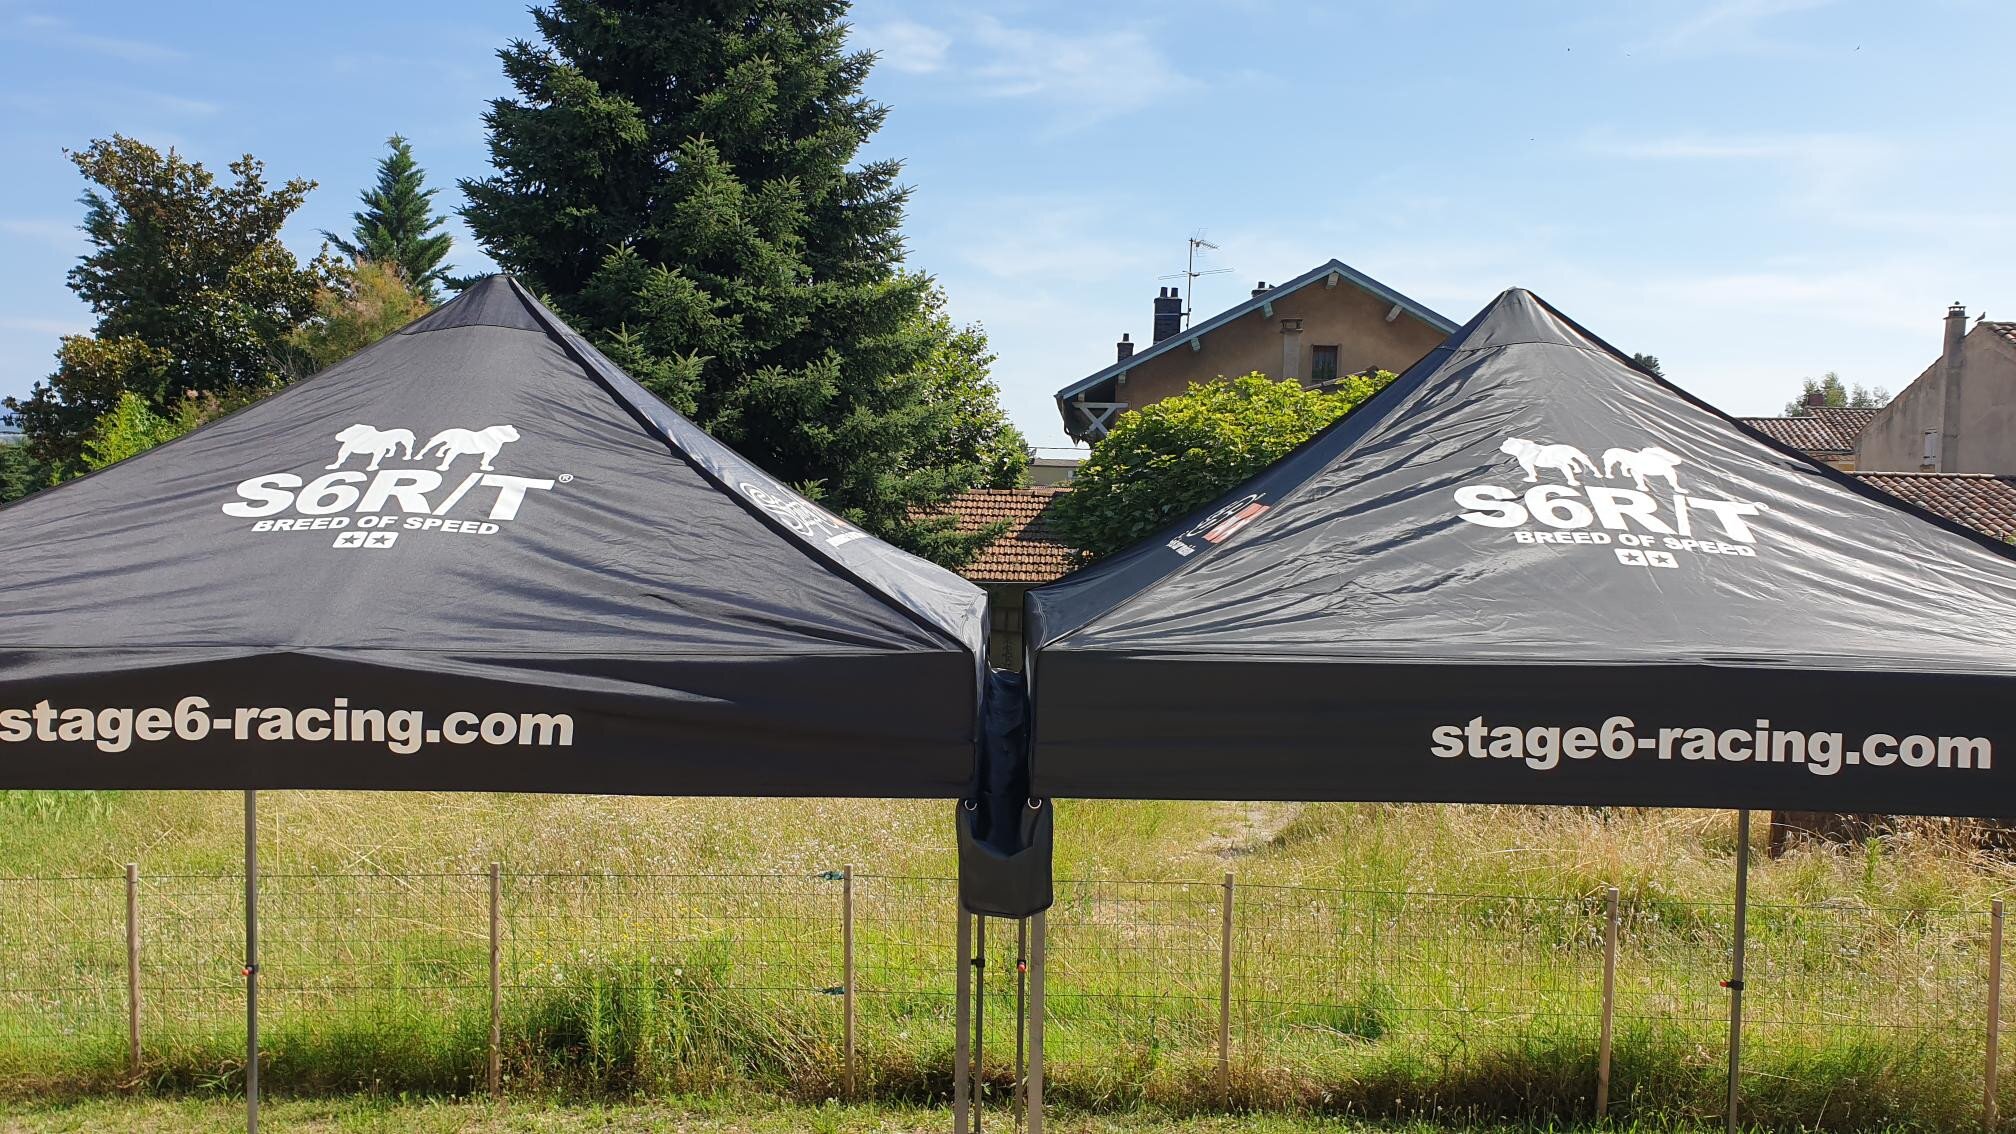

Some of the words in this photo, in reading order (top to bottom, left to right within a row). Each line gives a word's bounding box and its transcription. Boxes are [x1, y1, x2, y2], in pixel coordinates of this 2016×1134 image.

[251, 516, 350, 532] BREED
[357, 515, 399, 529] OF
[403, 517, 500, 535] SPEED
[1513, 531, 1612, 545] BREED
[1619, 532, 1655, 547] OF
[1663, 537, 1757, 557] SPEED
[0, 696, 574, 754] stage6-racing.com
[1431, 716, 1992, 776] stage6-racing.com
